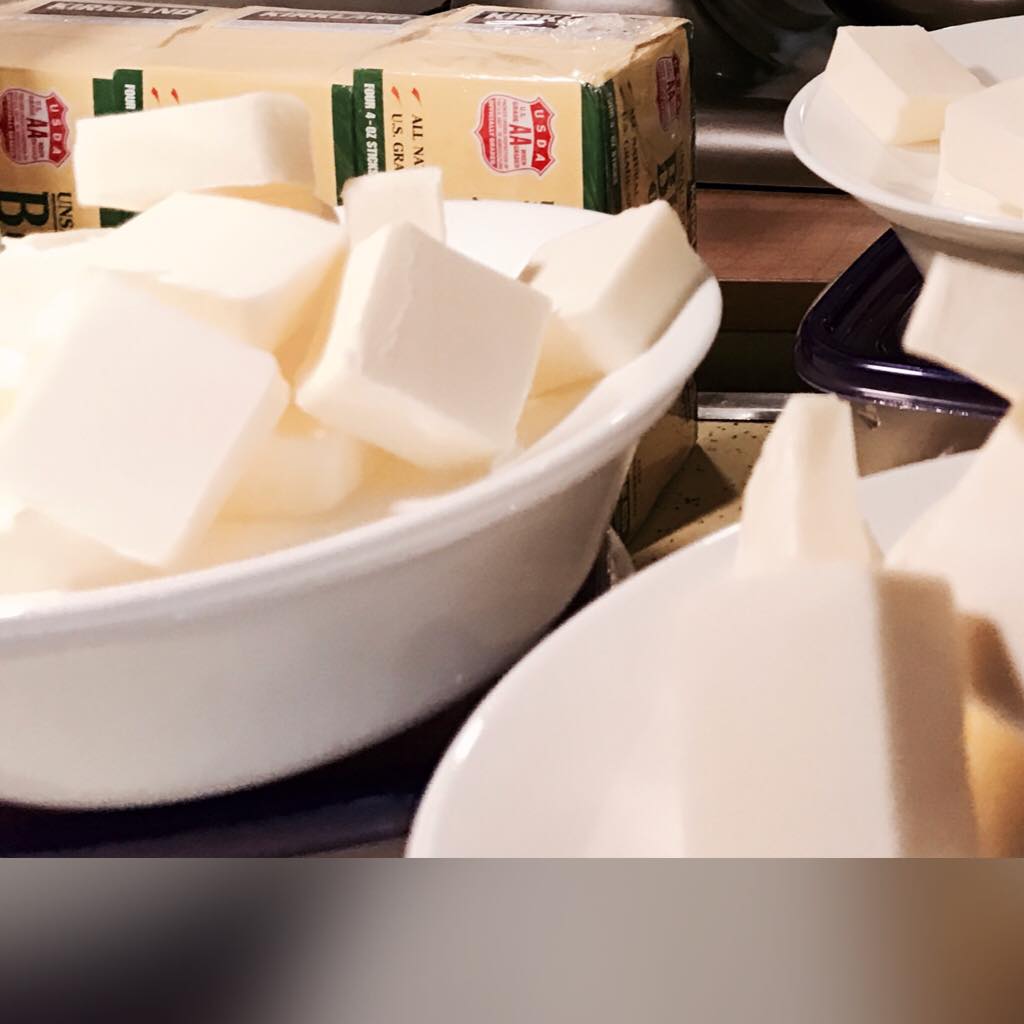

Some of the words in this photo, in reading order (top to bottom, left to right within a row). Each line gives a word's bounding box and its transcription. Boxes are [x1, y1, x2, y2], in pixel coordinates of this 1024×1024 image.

[46, 2, 199, 18] KIRKLAND
[124, 83, 137, 111] FOUR
[364, 83, 376, 110] FOUR
[26, 117, 48, 139] AA
[49, 103, 62, 154] USDA
[391, 113, 404, 138] U.S.
[412, 114, 424, 141] ALL
[509, 124, 532, 146] AA
[535, 109, 547, 162] USDA
[393, 142, 405, 171] GRA
[413, 146, 425, 167] NA
[0, 191, 49, 238] B
[57, 192, 74, 232] UNS
